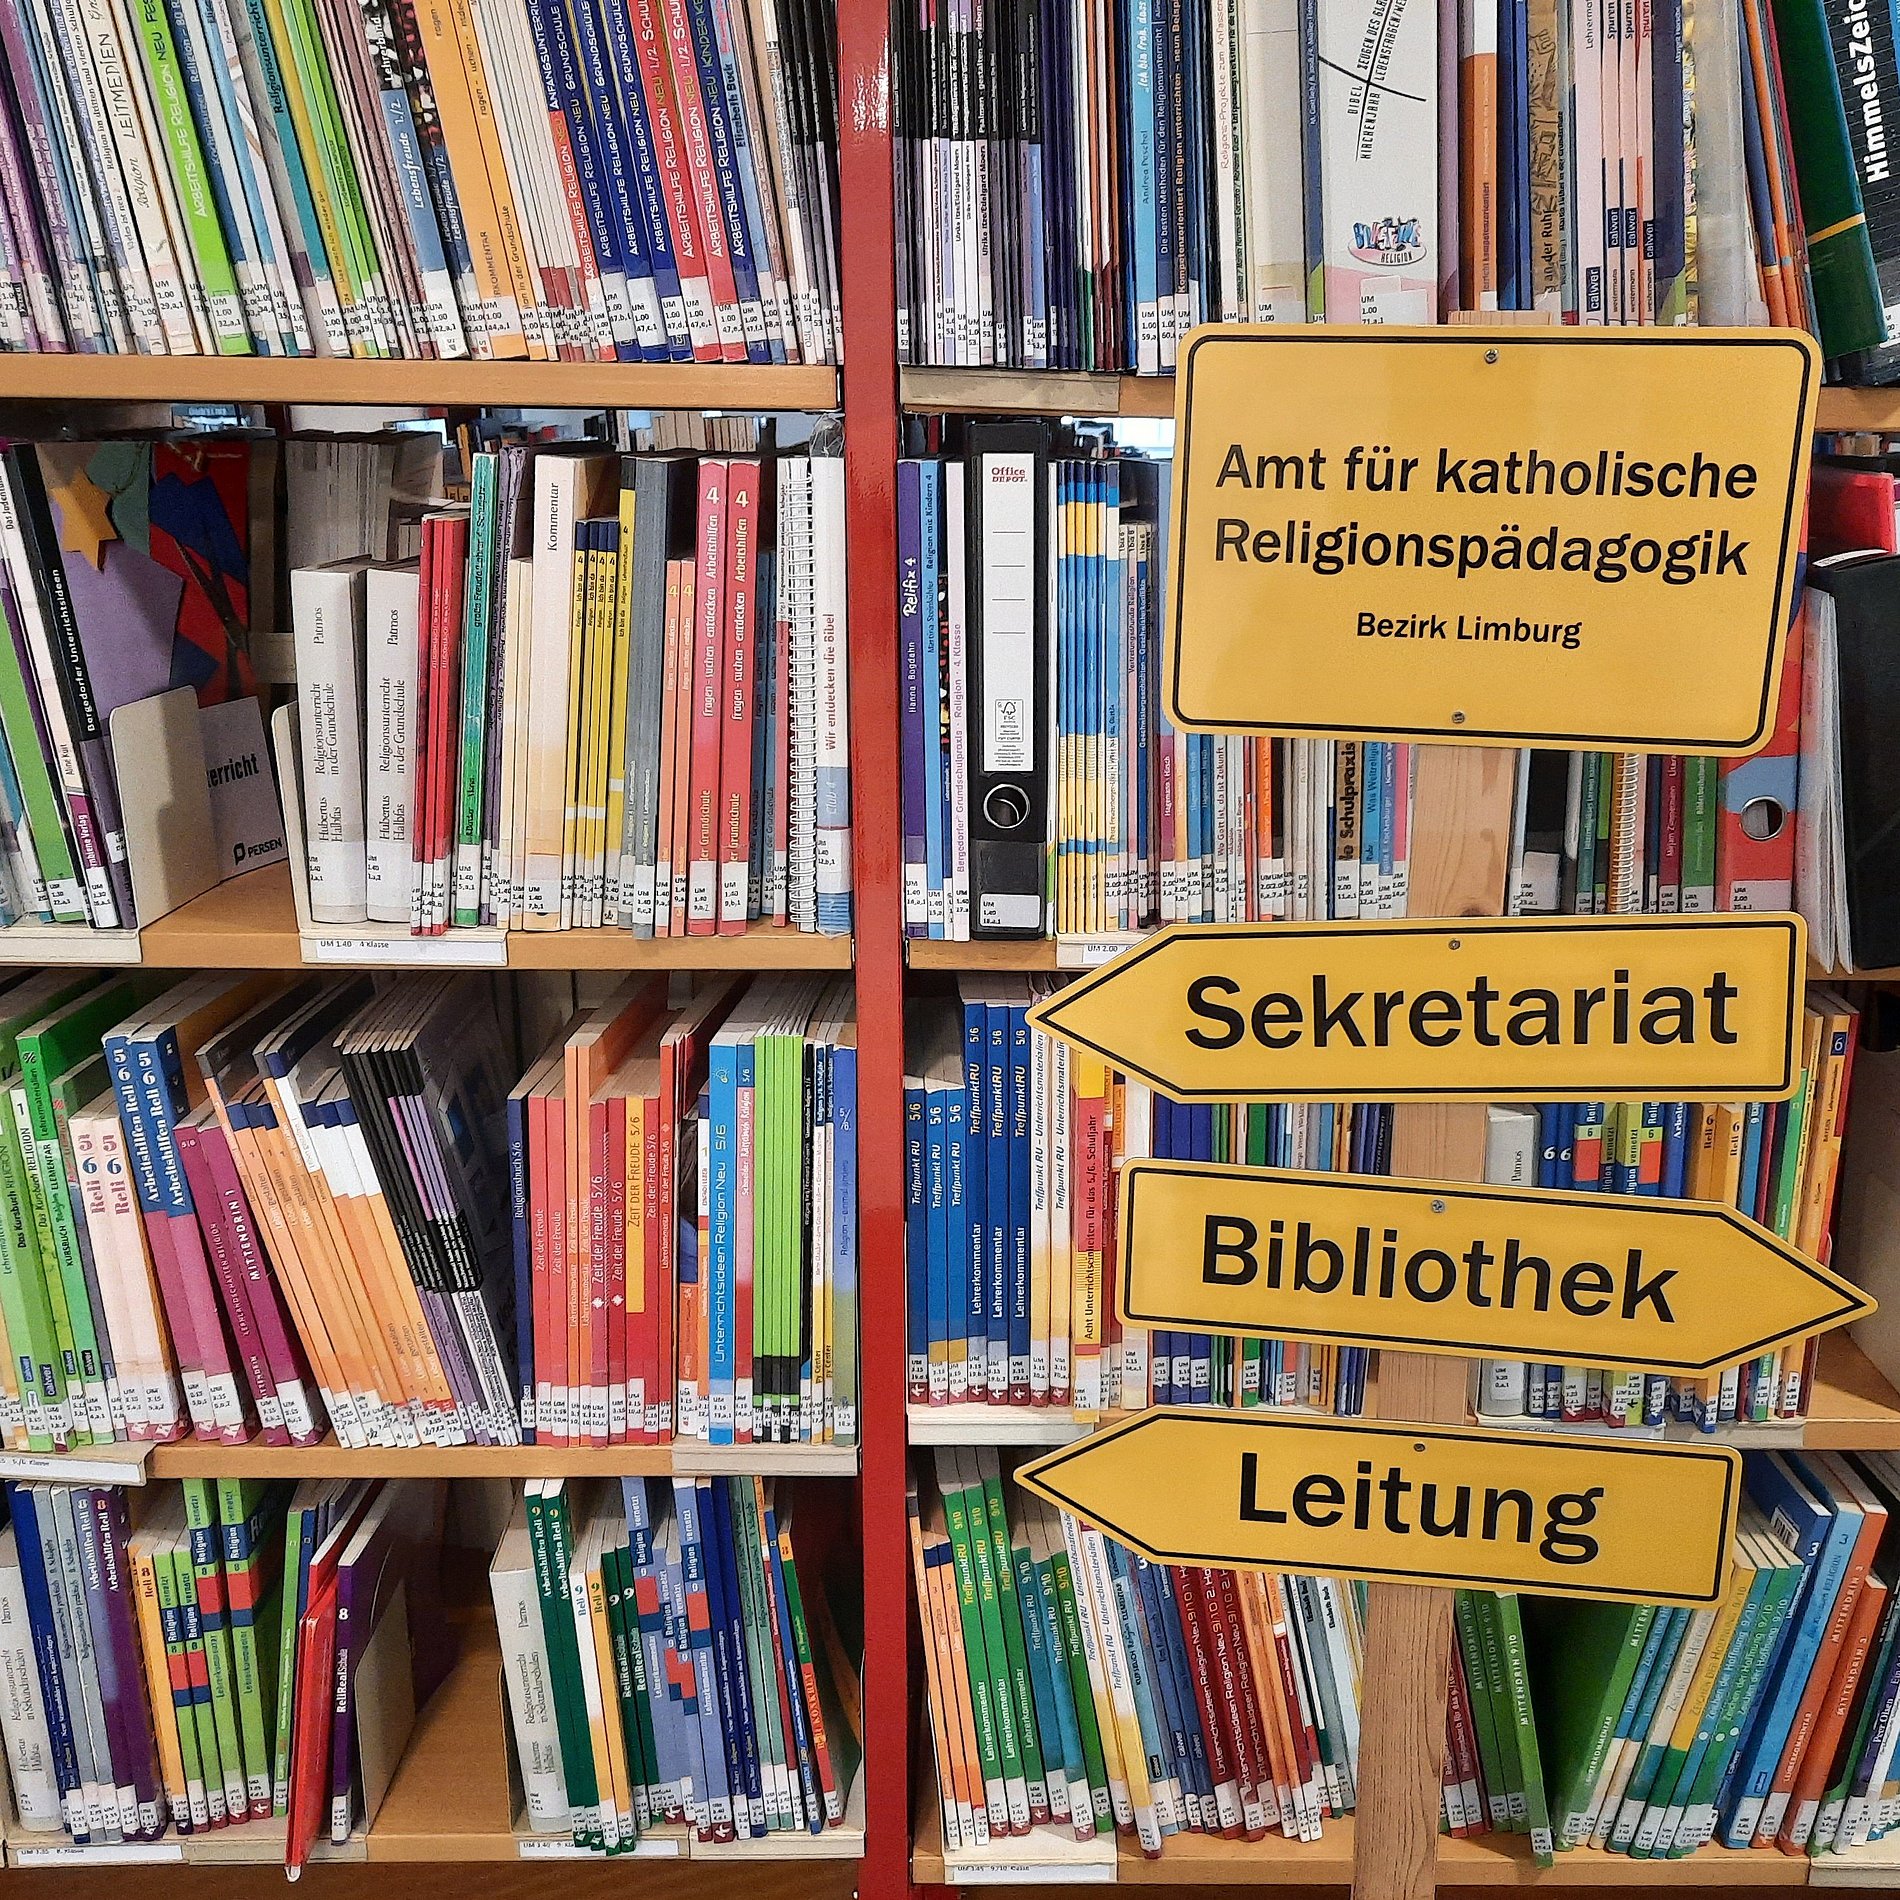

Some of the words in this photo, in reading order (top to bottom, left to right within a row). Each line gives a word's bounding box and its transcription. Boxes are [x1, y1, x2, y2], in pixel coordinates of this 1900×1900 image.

[1607, 2, 1616, 39] Spuren
[1625, 2, 1633, 39] Spuren
[150, 32, 167, 61] NEU
[248, 1, 284, 113] Religionsunterricht
[373, 16, 395, 81] Lehrerband
[550, 6, 577, 90] GRUNDSCHULE
[581, 1, 606, 86] GRUNDSCHULE
[1358, 38, 1374, 70] ZEUGEN
[1368, 19, 1380, 35] DES
[723, 63, 735, 91] Buck
[1155, 28, 1167, 117] Religionsunterricht
[160, 63, 182, 125] RELIGION
[570, 99, 582, 123] NEU
[600, 95, 611, 119] NEU
[1347, 86, 1362, 114] BIBEL
[730, 94, 746, 147] Elisabeth
[1157, 120, 1165, 137] den
[1361, 92, 1380, 159] KIRCHENJAHR
[576, 127, 594, 178] RELIGION
[606, 123, 622, 175] RELIGION
[1140, 130, 1149, 163] Peschel
[1157, 139, 1166, 153] für
[176, 129, 208, 218] ARBEITSHILFE
[399, 132, 424, 208] Lebensfreude
[1141, 165, 1149, 204] Andrea
[1158, 156, 1167, 203] Methoden
[441, 179, 462, 239] Lebensfreude
[588, 182, 612, 257] ARBEITSHILFE
[615, 179, 639, 255] ARBEITSHILFE
[1159, 206, 1168, 237] besten
[1610, 210, 1619, 245] calwer
[1628, 210, 1636, 245] calwer
[1161, 239, 1169, 254] Die
[1589, 269, 1600, 309] calwer
[991, 468, 1026, 477] Office
[1216, 444, 1327, 488] Amt
[1344, 446, 1418, 492] für
[1436, 448, 1758, 498] katholische
[707, 487, 719, 503] 4
[547, 483, 559, 551] Kommentar
[706, 515, 719, 578] Arbeitshilfen
[904, 558, 915, 566] 4
[1216, 518, 1750, 584] Religionspädagogik
[902, 570, 919, 616] Relifix
[51, 569, 81, 662] Unterrichtsideen
[312, 607, 324, 645] Patmos
[388, 610, 399, 646] Patmos
[706, 588, 717, 638] entdecken
[823, 613, 835, 642] Bibel
[1357, 613, 1447, 639] Bezirk
[1457, 615, 1582, 649] Limburg
[704, 646, 716, 678] suchen
[824, 647, 835, 670] die
[907, 642, 917, 680] Bogdahn
[72, 665, 95, 731] Bergedorfer
[703, 686, 715, 717] fragen
[824, 675, 836, 727] entdecken
[907, 685, 916, 713] Hanna
[311, 684, 325, 774] Religionsunterricht
[380, 677, 392, 773] Religionsunterricht
[825, 732, 836, 751] Wir
[827, 794, 837, 814] Club
[1339, 742, 1357, 838] Schulpraxis
[77, 815, 92, 838] Verlag
[317, 797, 329, 841] Hubertus
[379, 796, 391, 840] Hubertus
[699, 790, 712, 845] Grundschule
[246, 838, 282, 857] PERSEN
[1185, 970, 1738, 1050] Sekretariat
[970, 1027, 980, 1042] 5/6
[992, 1030, 1003, 1045] 5/6
[30, 1067, 49, 1136] Lehrermaterialien
[909, 1103, 921, 1120] 5/6
[930, 1107, 941, 1125] 5/6
[512, 1142, 522, 1156] 5/6
[714, 1124, 727, 1150] 5/6
[912, 1141, 920, 1155] RU
[933, 1144, 941, 1158] RU
[1544, 1147, 1554, 1160] 6
[1604, 1127, 1614, 1161] vernetzt
[1629, 1129, 1638, 1163] vernetzt
[1, 1145, 18, 1188] RELIGION
[43, 1144, 59, 1190] ELEMENTAR
[715, 1162, 726, 1190] Neu
[912, 1158, 921, 1204] Treffpunkt
[1512, 1151, 1522, 1181] Patmos
[513, 1158, 524, 1218] Religionsbuch
[590, 1176, 603, 1199] 5/6
[611, 1181, 622, 1202] 5/6
[932, 1162, 942, 1208] Treffpunkt
[7, 1191, 25, 1231] Kursbuch
[592, 1206, 603, 1246] Freude
[611, 1209, 622, 1243] Freude
[714, 1192, 727, 1245] Religion
[15, 1232, 27, 1248] Das
[59, 1225, 74, 1266] KURSBUCH
[592, 1249, 603, 1262] der
[612, 1247, 622, 1261] der
[592, 1266, 604, 1283] Zeit
[612, 1264, 623, 1281] Zeit
[972, 1223, 982, 1315] Lehrerkommentar
[993, 1226, 1003, 1317] Lehrerkommentar
[1202, 1214, 1679, 1324] Bibliothek
[714, 1247, 727, 1362] Unterrichtsideen
[20, 1357, 32, 1382] calwer
[41, 1364, 57, 1395] calwer
[84, 1352, 94, 1375] calwer
[98, 1512, 110, 1530] Reli
[953, 1511, 963, 1529] 9/10
[972, 1508, 984, 1526] 9/10
[1240, 1453, 1604, 1565] Leitung
[534, 1519, 544, 1538] Reli
[100, 1532, 120, 1592] Arbeitshilfen
[539, 1540, 553, 1597] Arbeitshilfen
[1019, 1561, 1032, 1583] 9/10
[160, 1576, 172, 1607] vernetzt
[181, 1573, 193, 1603] vernetzt
[591, 1595, 603, 1614] Reli
[1026, 1595, 1034, 1607] RU
[184, 1606, 198, 1638] Religion
[1183, 1594, 1196, 1620] 9/10
[1741, 1603, 1756, 1626] 9/10
[1759, 1605, 1773, 1628] 9/10
[165, 1610, 179, 1642] Religion
[1028, 1611, 1041, 1650] Treffpunkt
[1189, 1621, 1201, 1643] Neu
[1194, 1645, 1211, 1682] Religion
[1466, 1626, 1483, 1689] MITTENDRIN
[1720, 1631, 1740, 1670] Hoffnung
[1737, 1635, 1758, 1673] Hoffnung
[1512, 1658, 1529, 1725] MITTENDRIN
[1716, 1672, 1725, 1686] der
[1733, 1675, 1742, 1688] der
[976, 1681, 995, 1760] Lehrerkommentar
[997, 1678, 1015, 1758] Lehrerkommentar
[1706, 1690, 1721, 1719] Zeichen
[1724, 1691, 1739, 1720] Zeichen
[1206, 1685, 1226, 1774] Unterrichtsideen
[1785, 1712, 1812, 1781] LEHRERKOMMENTAR
